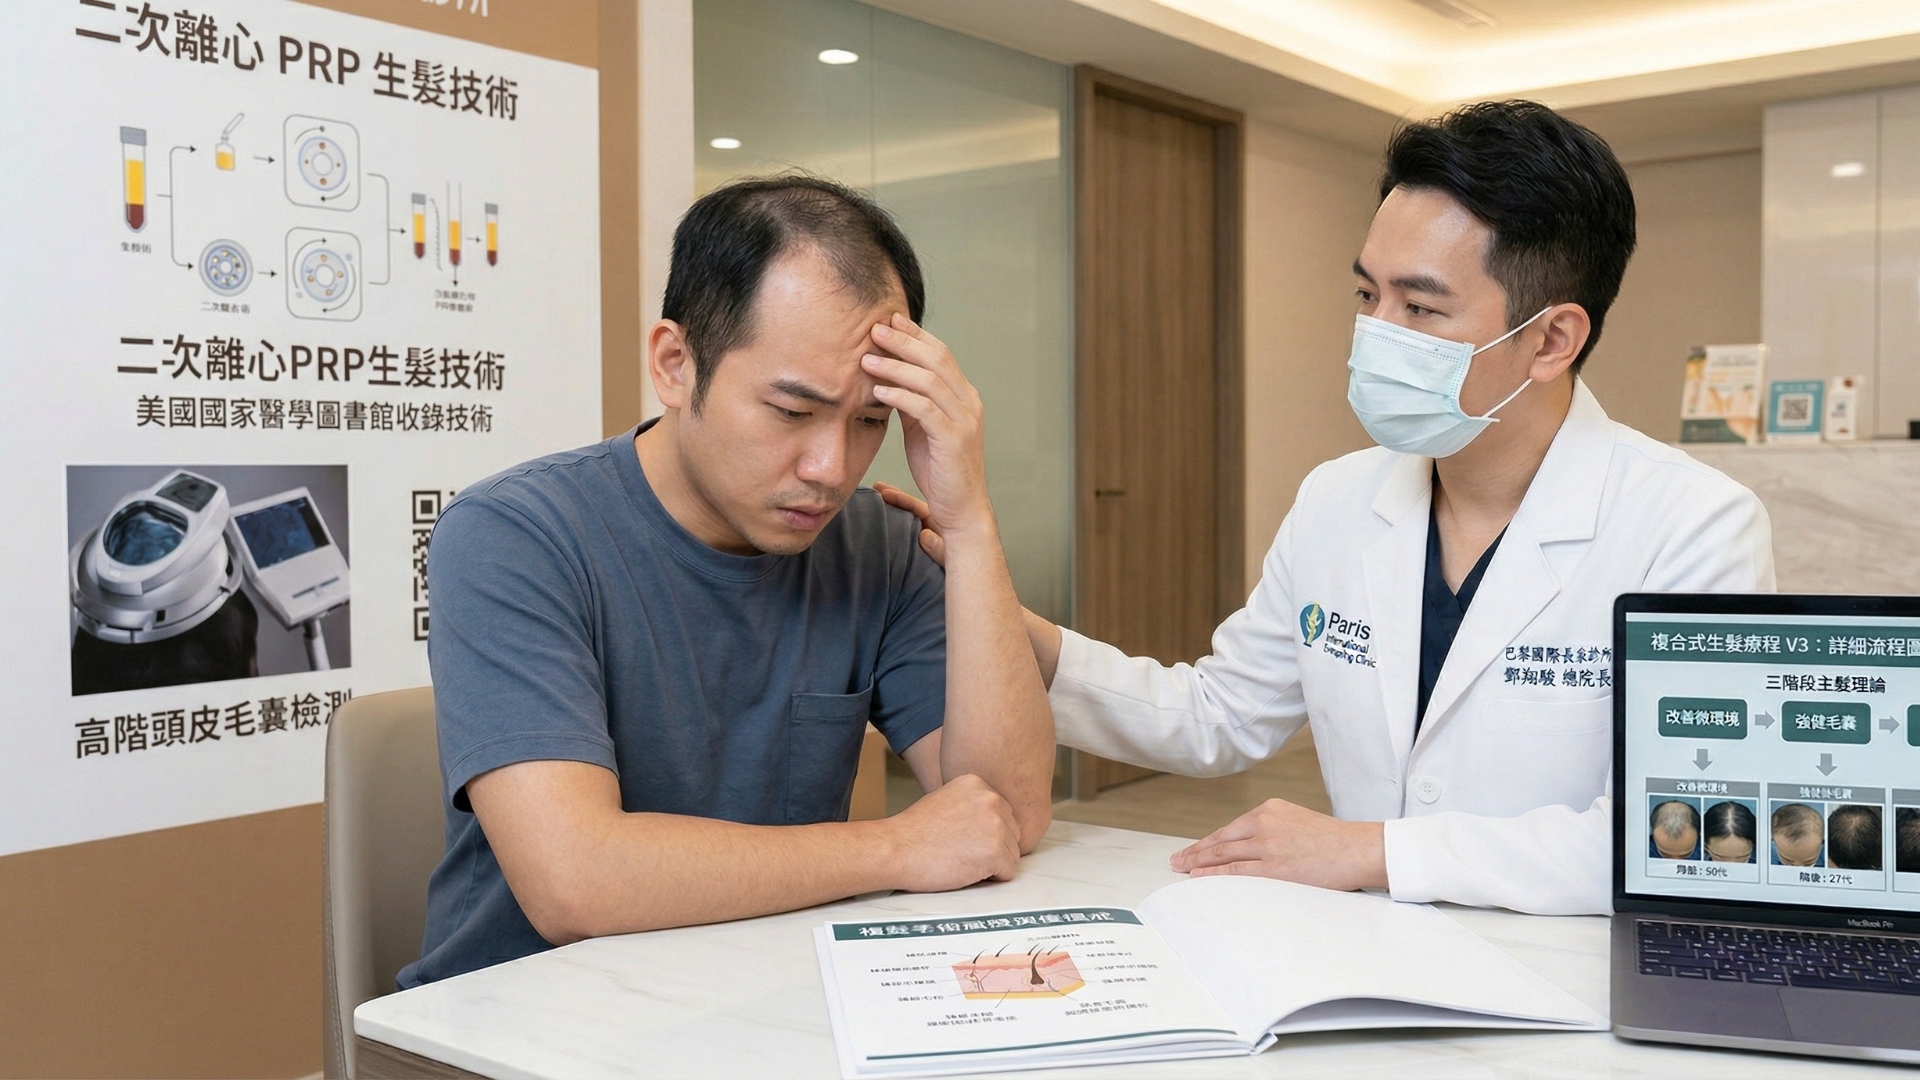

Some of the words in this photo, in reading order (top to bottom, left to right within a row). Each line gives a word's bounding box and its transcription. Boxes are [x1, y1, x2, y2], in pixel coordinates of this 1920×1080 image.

[76, 0, 264, 71] 二次離心
[279, 35, 361, 85] PRP
[373, 51, 519, 121] 生髮技術
[117, 333, 506, 391] 二次離心PRP生髮技術
[136, 394, 494, 432] 美國國家醫學圖書館收錄技術
[1328, 612, 1371, 640] Paris
[1650, 632, 1781, 654] 複合式生髮療程
